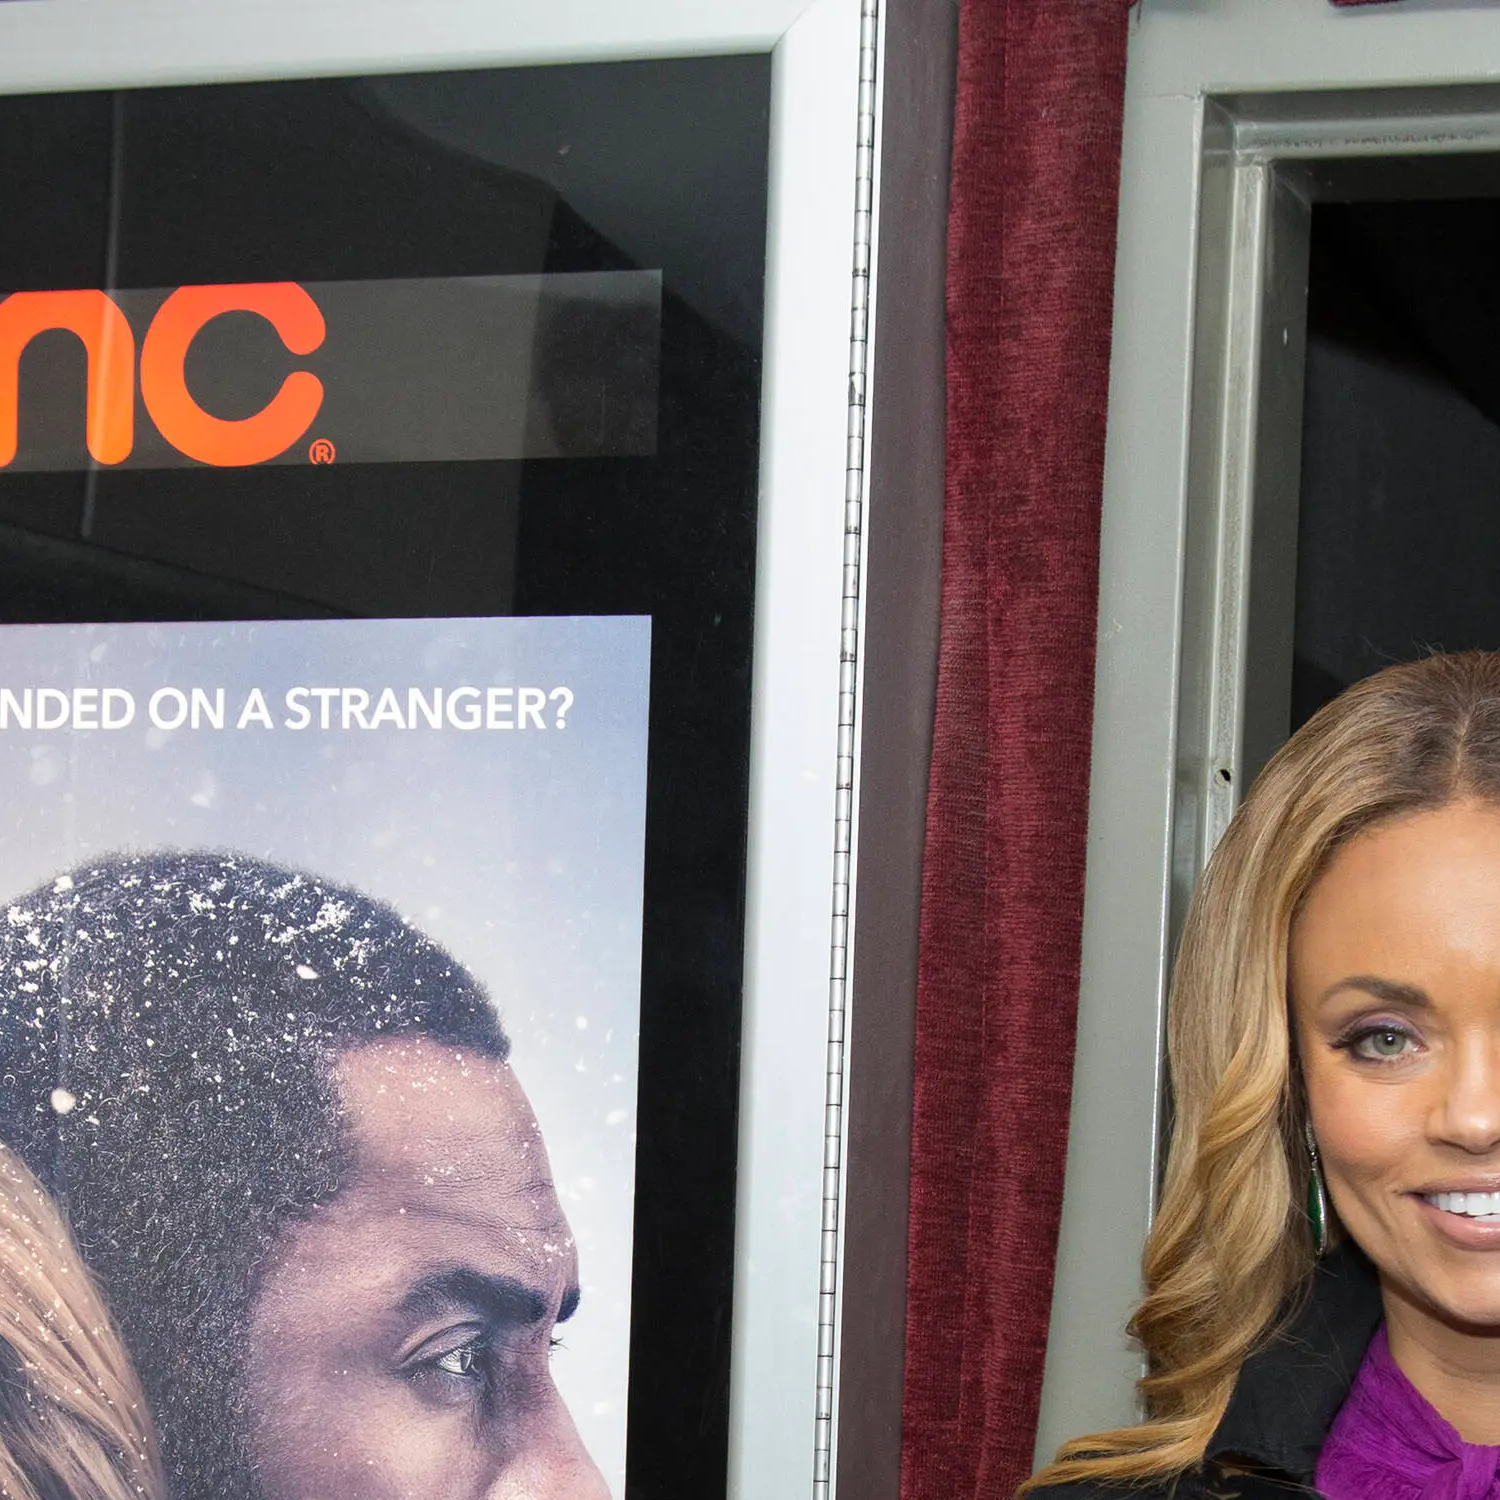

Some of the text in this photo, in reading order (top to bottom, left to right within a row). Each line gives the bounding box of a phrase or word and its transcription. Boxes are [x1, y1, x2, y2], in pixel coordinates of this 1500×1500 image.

[148, 687, 224, 730] ON
[237, 687, 274, 730] A
[285, 687, 574, 730] STRANGER?
